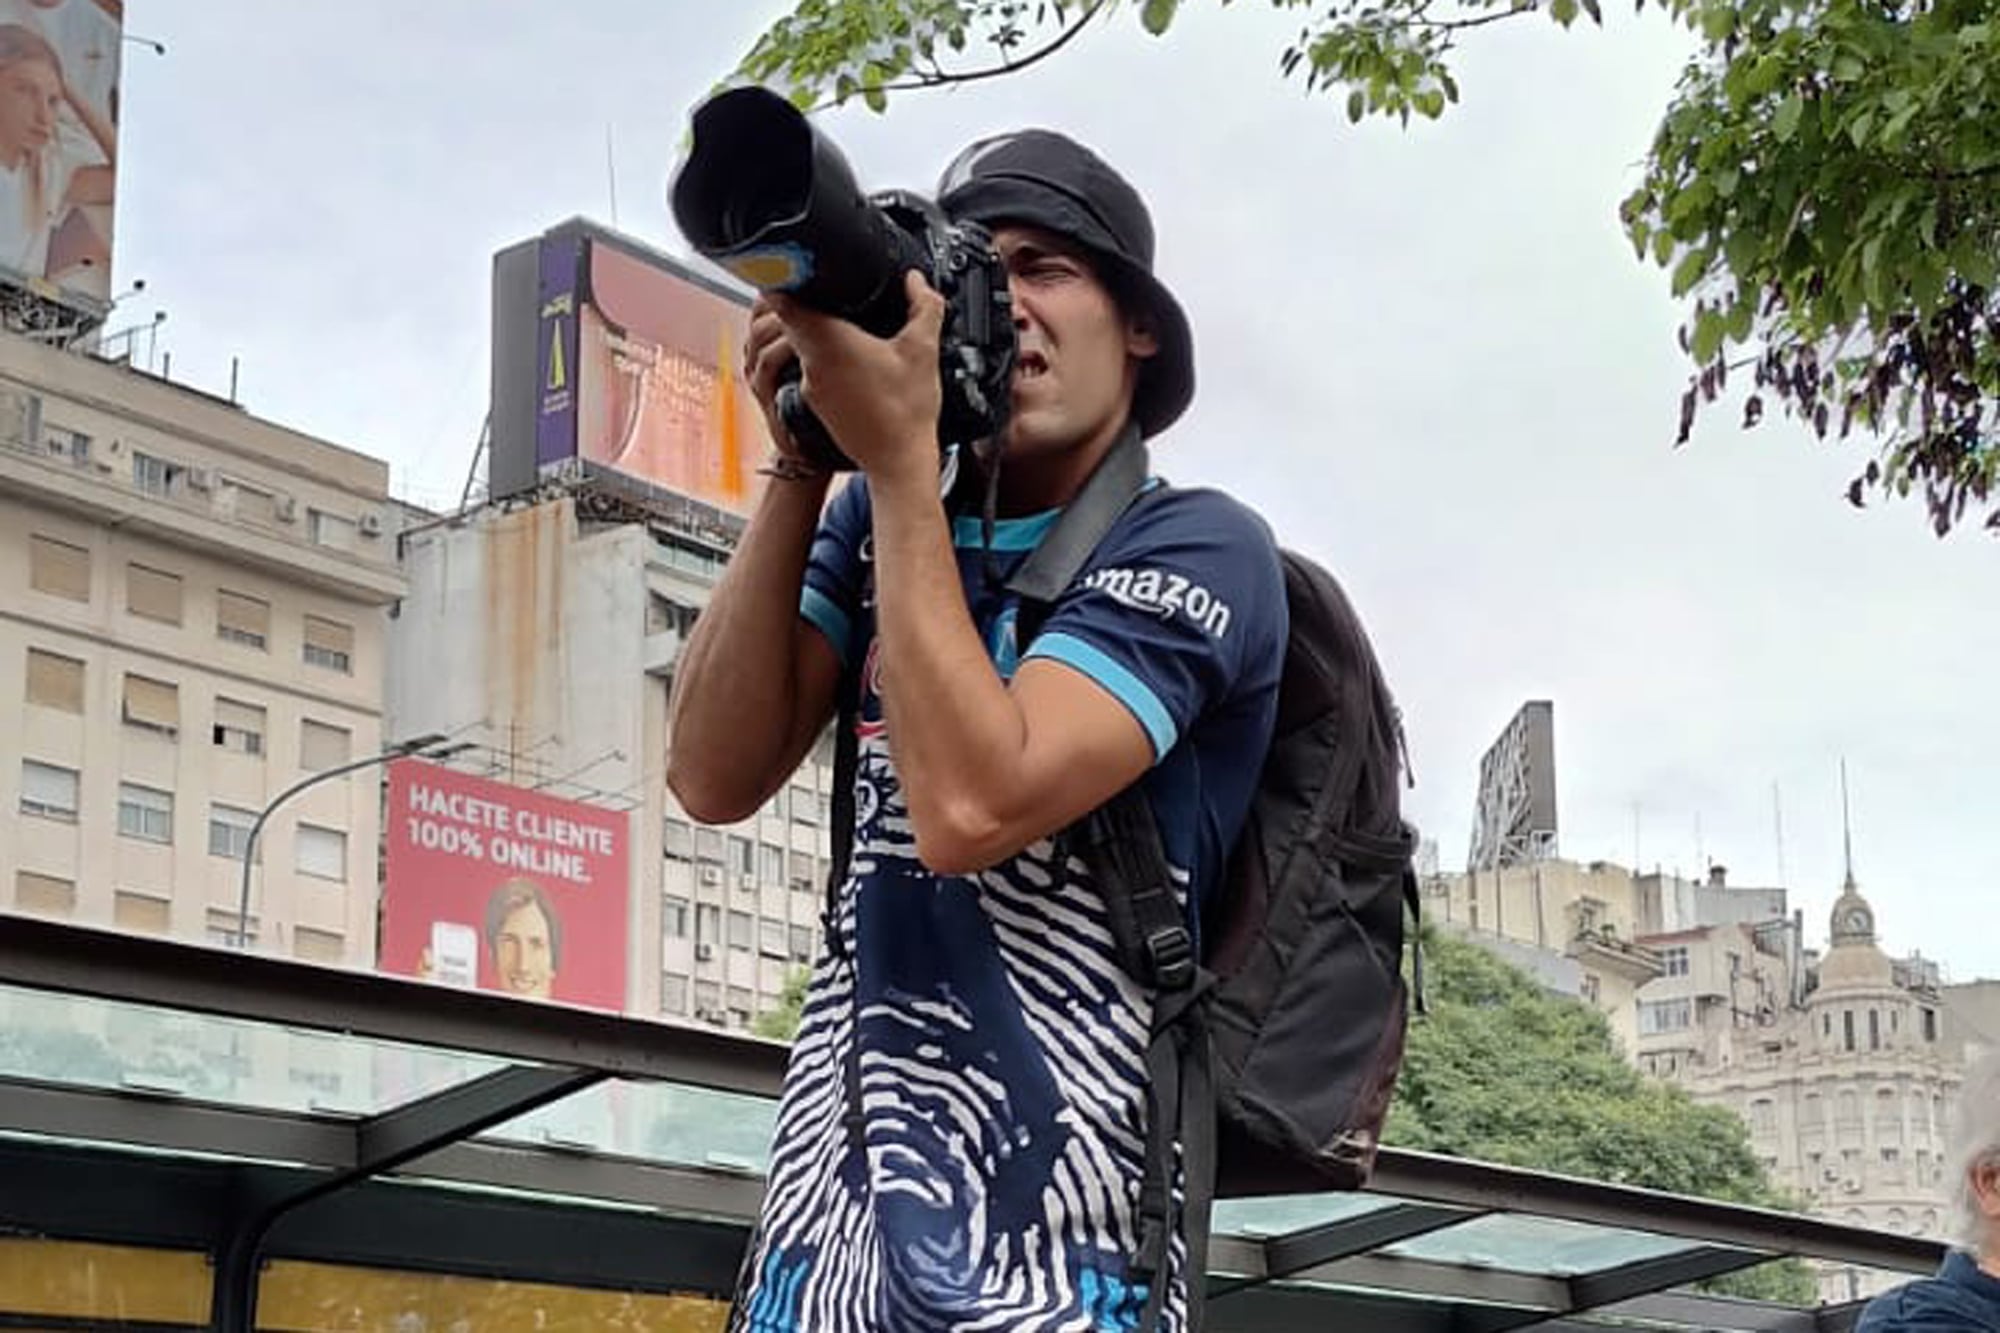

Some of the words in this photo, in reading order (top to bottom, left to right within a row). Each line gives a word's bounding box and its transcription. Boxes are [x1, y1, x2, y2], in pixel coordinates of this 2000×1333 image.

[408, 818, 484, 860] 100%
[491, 837, 592, 883] ONLINE.
[409, 783, 509, 832] HACETE
[516, 810, 613, 855] CLIENTE
